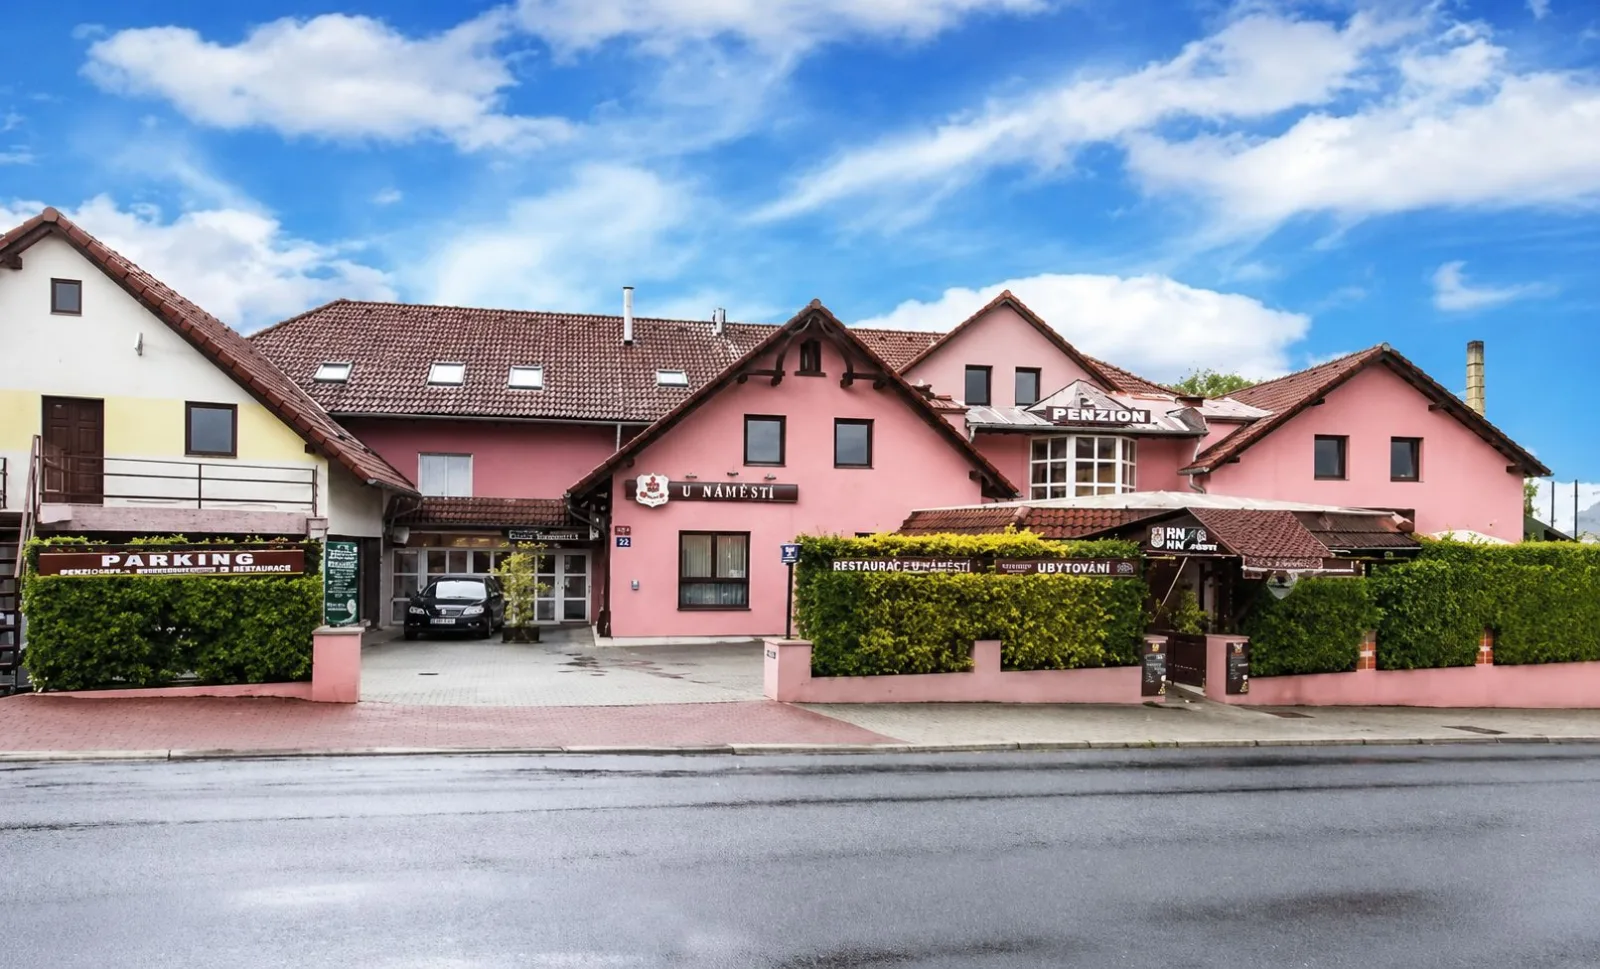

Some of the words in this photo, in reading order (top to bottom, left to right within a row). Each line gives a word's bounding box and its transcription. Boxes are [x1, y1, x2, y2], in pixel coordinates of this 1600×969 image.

[1052, 408, 1146, 422] PENZION
[682, 485, 691, 497] U
[703, 482, 775, 499] NÁMĚSTÍ
[619, 538, 630, 546] 22
[101, 553, 255, 567] PARKING
[1037, 561, 1110, 573] UBYTOVÁNÍ
